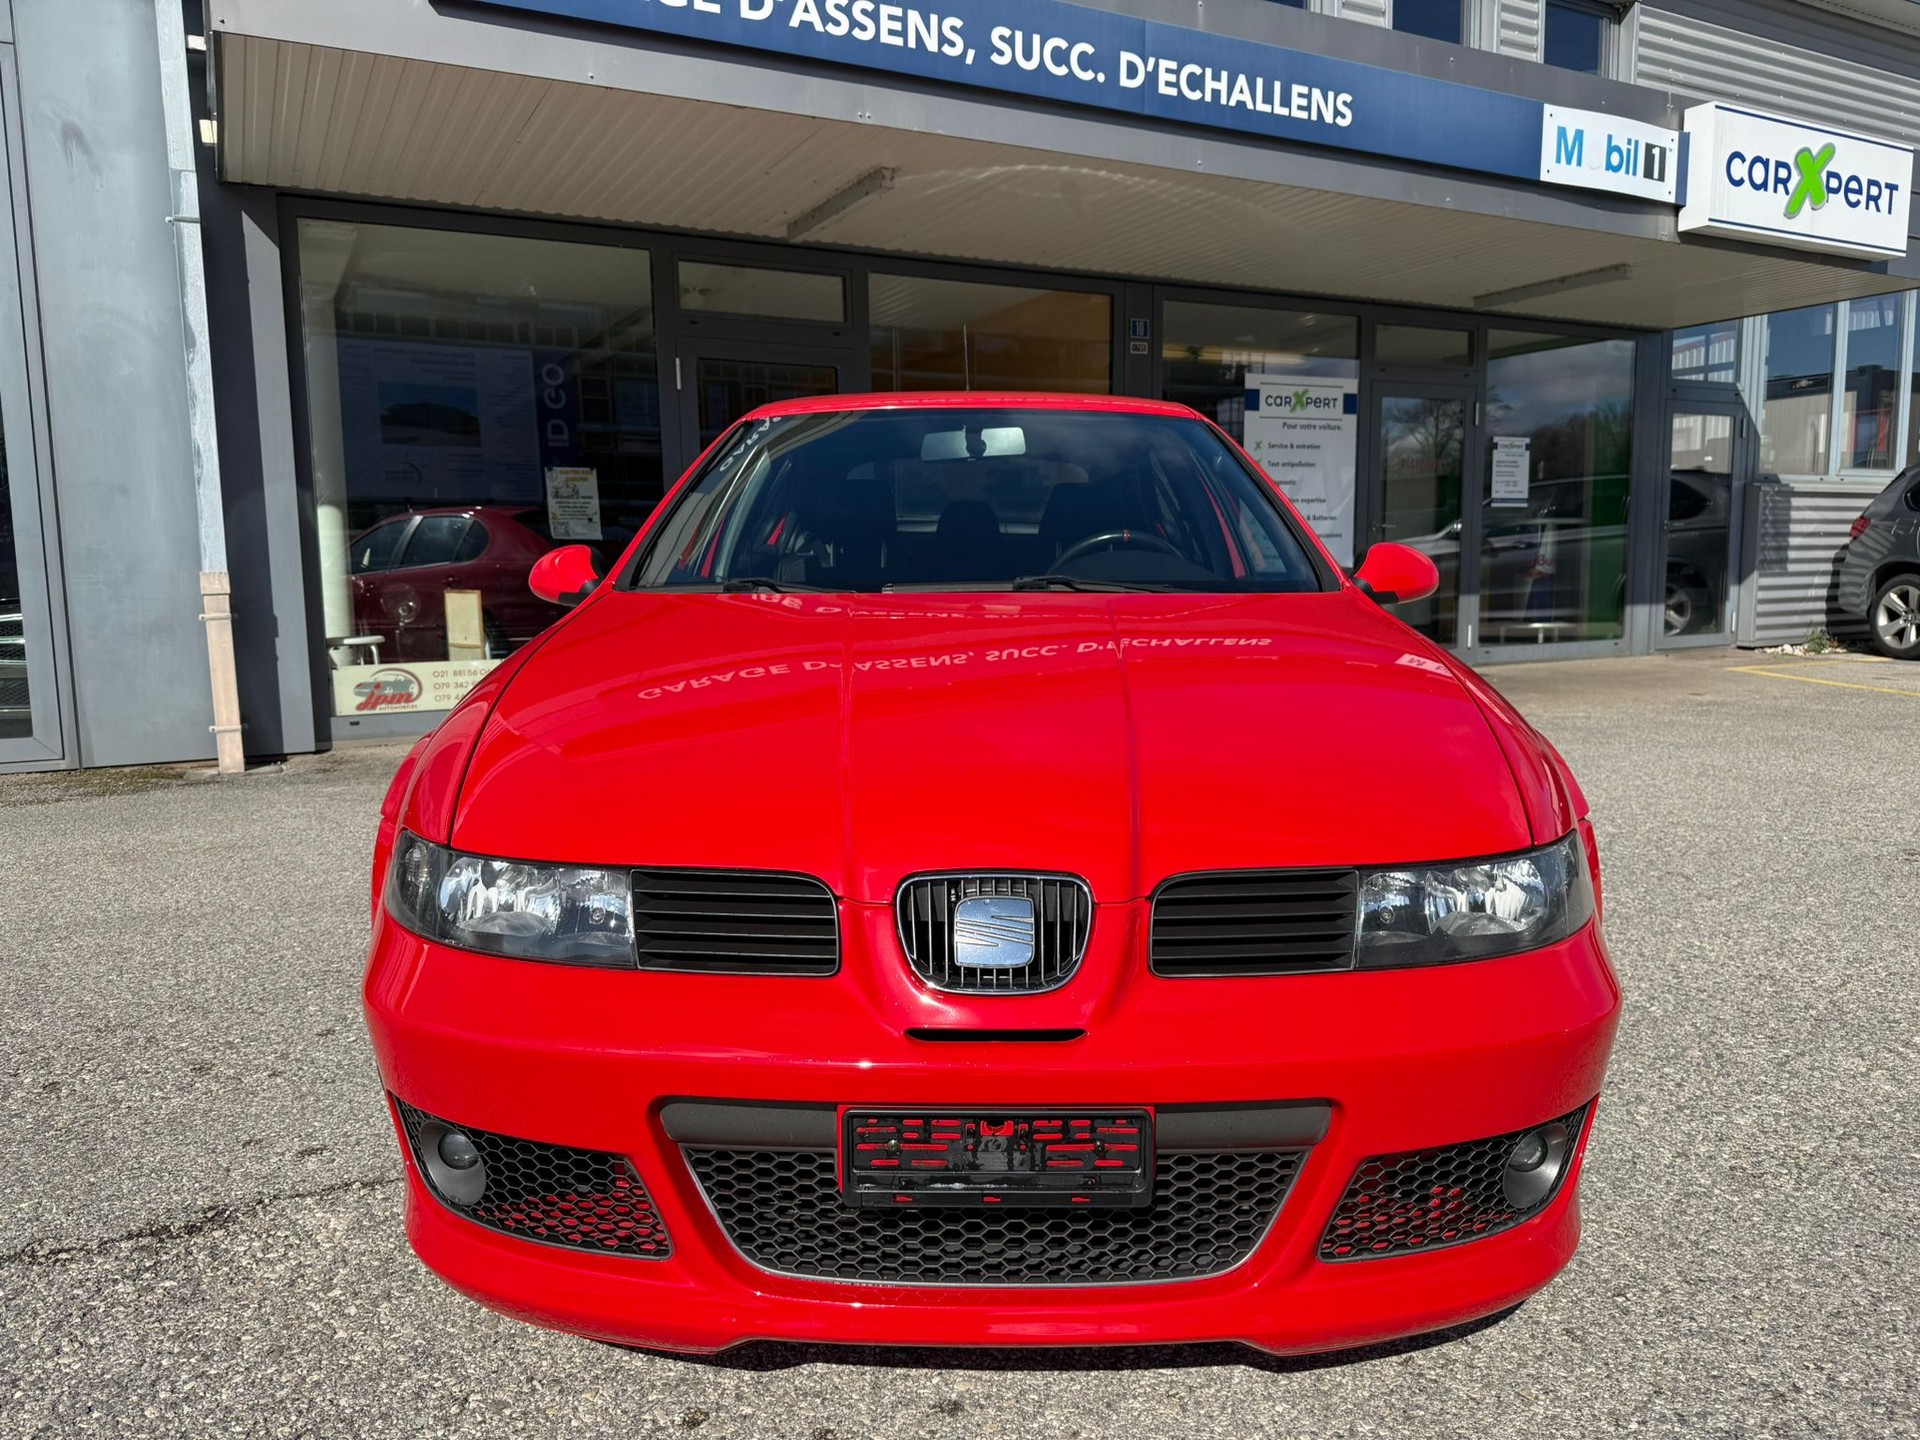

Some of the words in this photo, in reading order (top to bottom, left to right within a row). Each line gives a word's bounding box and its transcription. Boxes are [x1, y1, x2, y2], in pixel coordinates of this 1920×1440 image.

[740, 0, 976, 65] DASSENS,
[990, 27, 1105, 83] SUCC.
[1120, 52, 1353, 127] D'ECHALLENS
[1555, 126, 1639, 177] Mbil
[1282, 421, 1298, 431] Pour
[1300, 423, 1317, 432] votre
[1318, 422, 1343, 432] voiture.
[1268, 442, 1288, 450] Service
[1295, 442, 1321, 450] entretien
[1267, 460, 1280, 468] Test
[1281, 460, 1316, 469] antipollution
